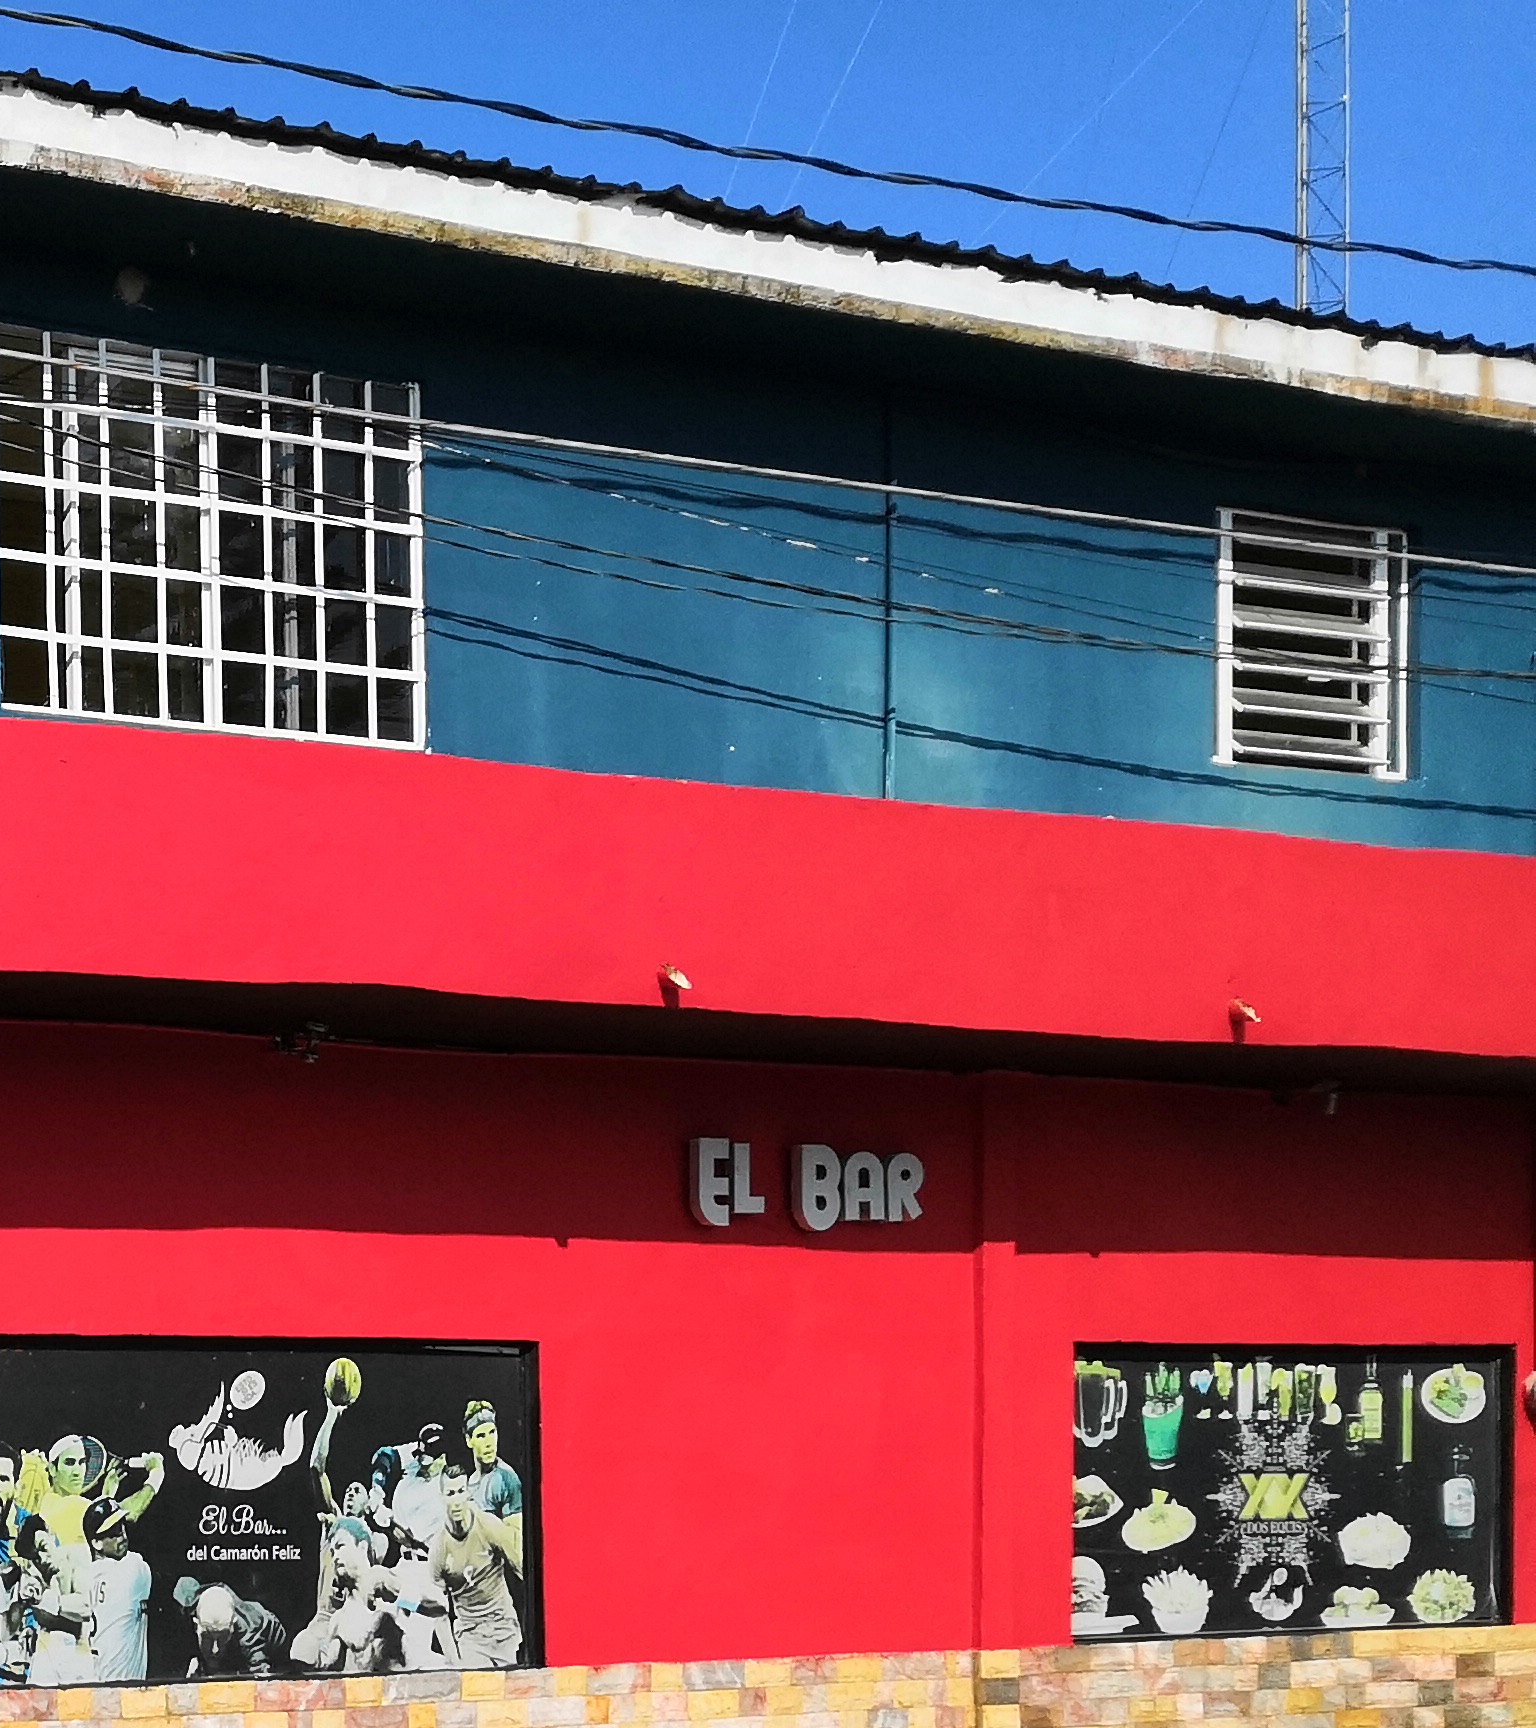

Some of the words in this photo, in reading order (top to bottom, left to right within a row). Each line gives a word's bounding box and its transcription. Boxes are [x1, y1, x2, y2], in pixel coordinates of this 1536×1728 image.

[689, 1137, 765, 1227] EL
[790, 1143, 925, 1232] BAR
[198, 1503, 228, 1535] El
[186, 1544, 208, 1561] del
[210, 1544, 269, 1561] Camarón
[272, 1544, 302, 1561] Feliz
